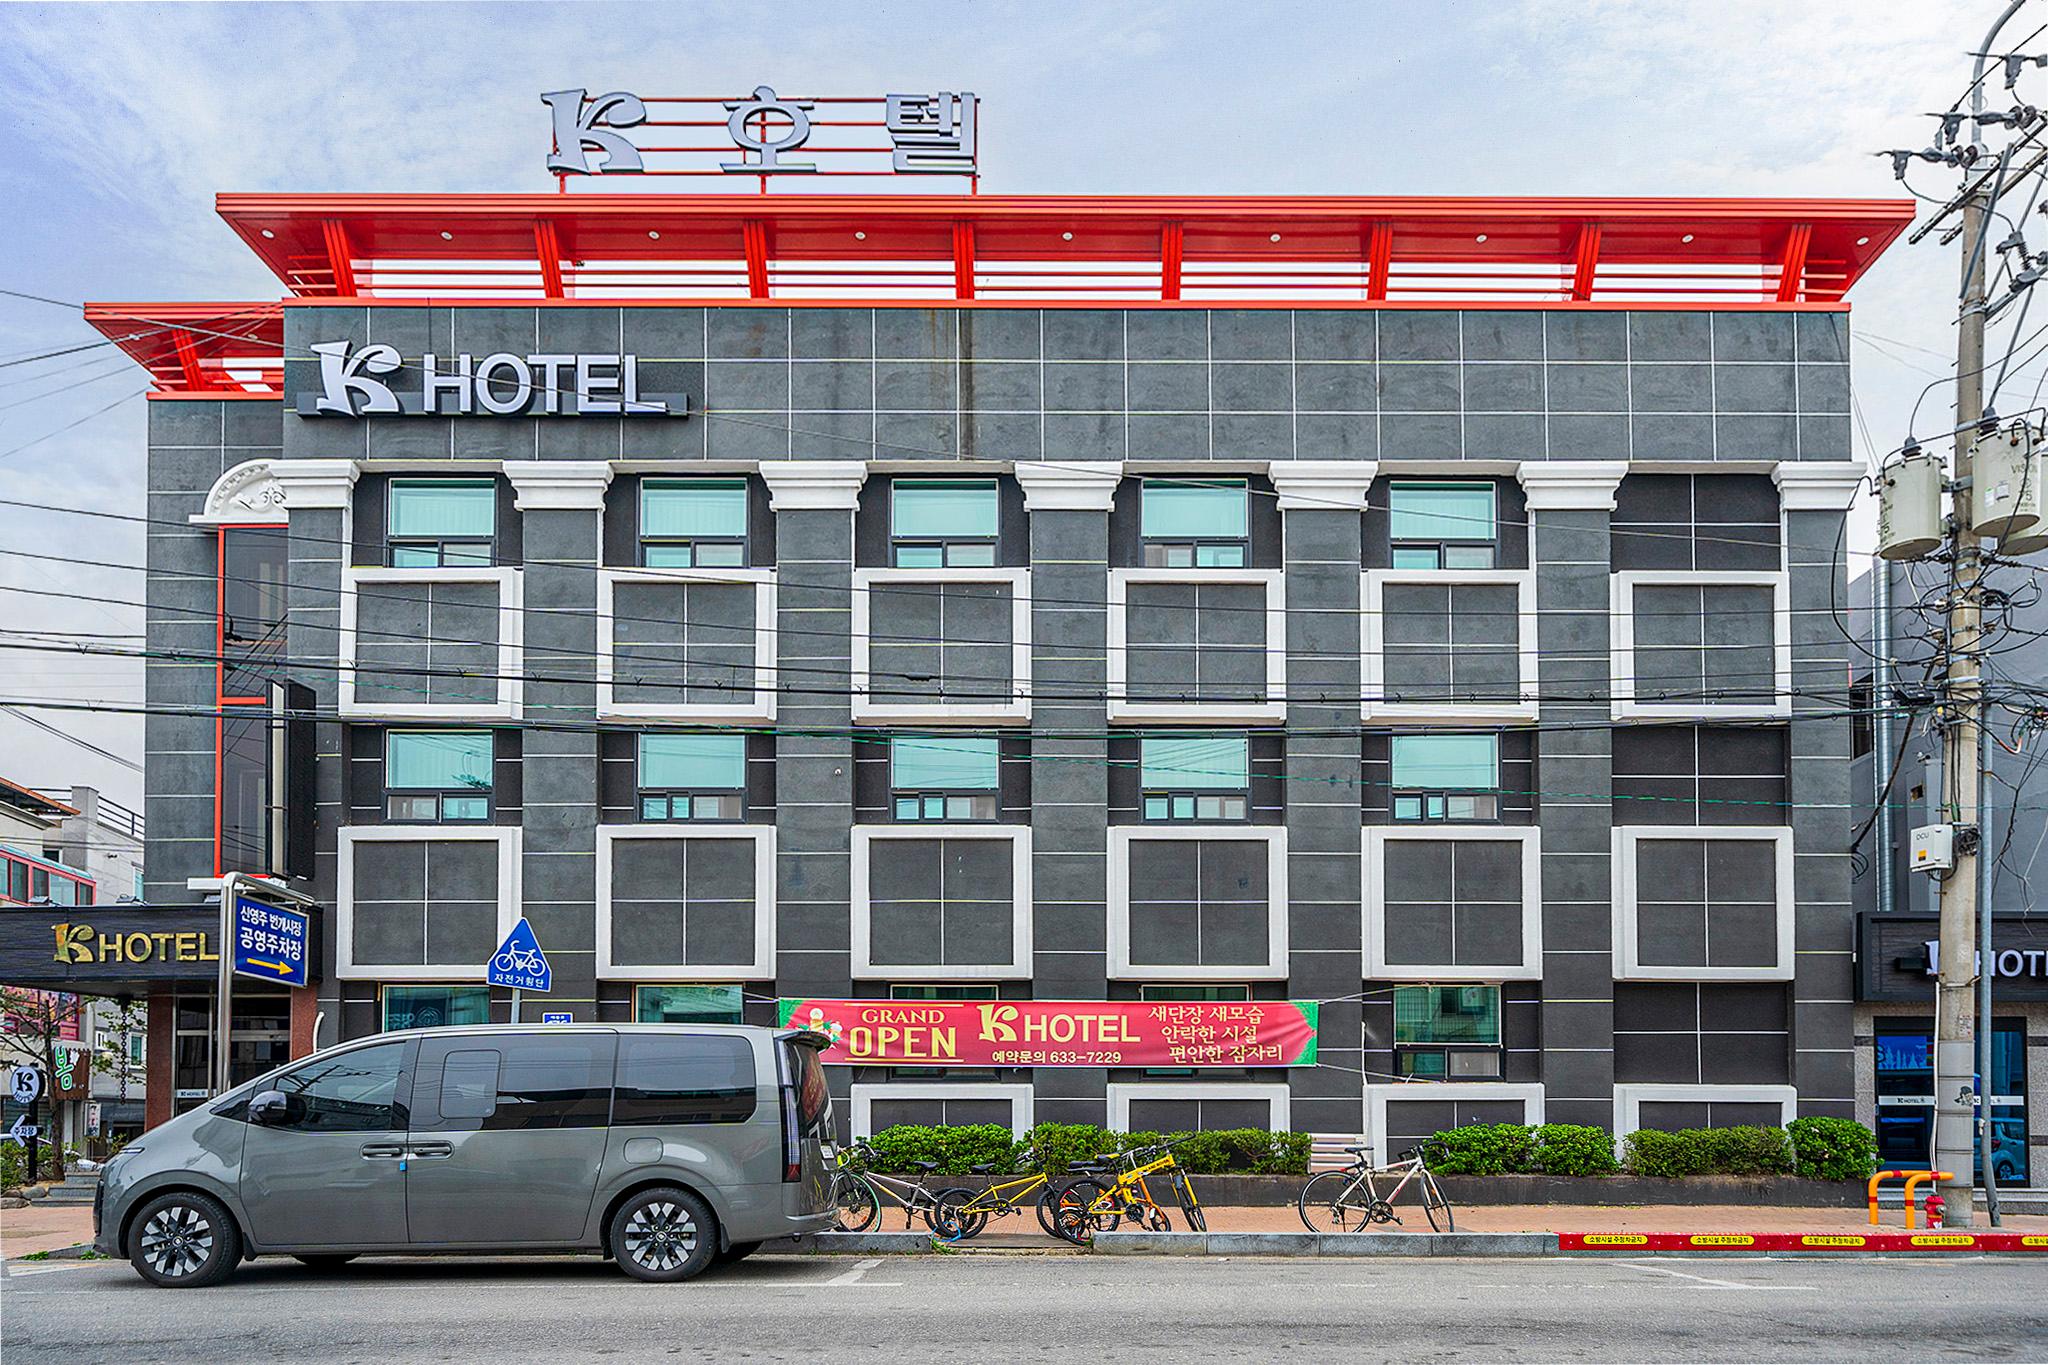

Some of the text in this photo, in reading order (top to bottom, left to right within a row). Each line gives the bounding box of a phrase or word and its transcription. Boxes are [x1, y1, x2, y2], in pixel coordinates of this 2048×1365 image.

[310, 340, 667, 417] K HOTEL
[241, 905, 302, 937] 신영주 번개시장
[51, 923, 220, 964] K HOTEL
[240, 926, 302, 961] 공영주차장
[1974, 950, 2048, 977] HOT
[494, 973, 544, 988] 자전거횡단
[862, 1009, 945, 1024] GRAND
[976, 1004, 1141, 1043] K HOTEL
[1148, 1005, 1265, 1025] 새단장 새모습
[850, 1026, 956, 1058] OPEN
[1161, 1025, 1257, 1044] 안락한 시설
[992, 1051, 1122, 1064] 예약문의 633-7229
[1169, 1044, 1283, 1064] 편안한 잠자리
[54, 1046, 75, 1090] 봄
[16, 1072, 35, 1092] K
[14, 1127, 34, 1135] 주차장
